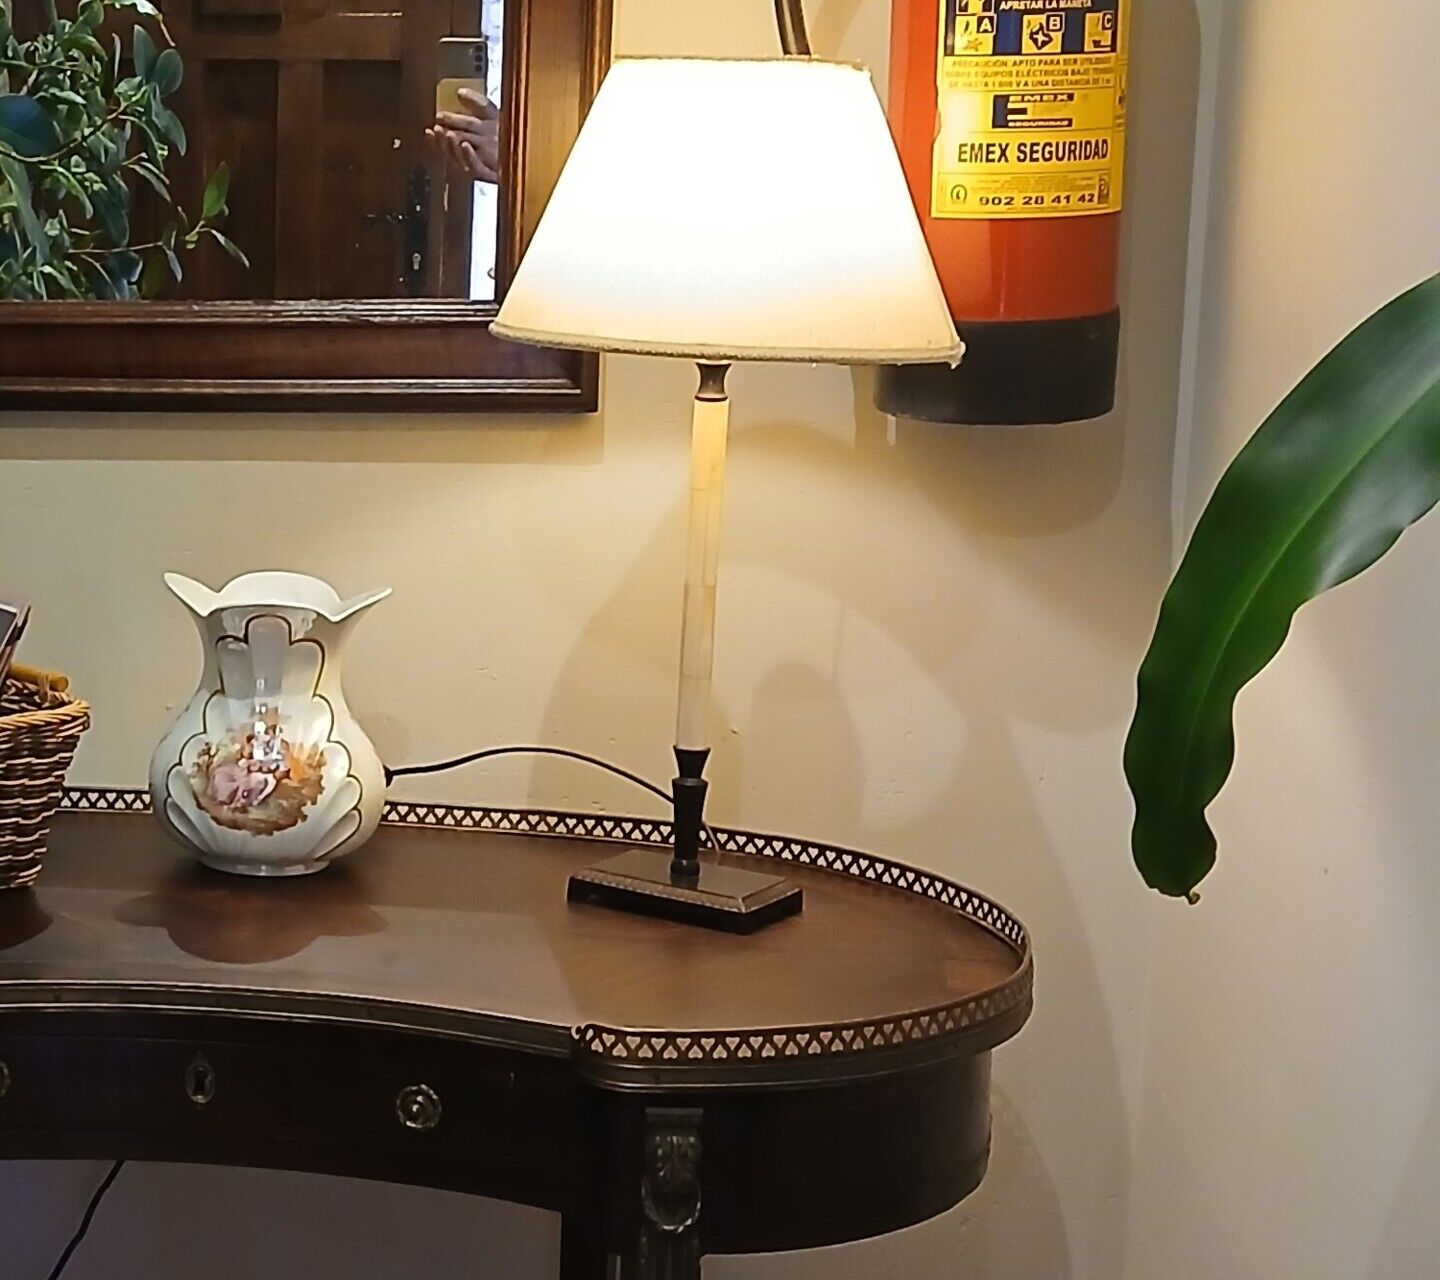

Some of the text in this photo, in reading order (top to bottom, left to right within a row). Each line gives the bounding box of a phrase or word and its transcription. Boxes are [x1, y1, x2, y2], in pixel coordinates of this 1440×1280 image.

[1045, 0, 1058, 9] LA
[978, 17, 992, 32] A
[1048, 16, 1061, 30] B
[1103, 14, 1113, 27] C
[1012, 57, 1036, 67] APTO
[1038, 57, 1061, 67] PARA
[1008, 93, 1069, 102] EMEX
[958, 138, 1109, 164] EMEX SEGURIDAD
[979, 195, 1015, 206] 902
[1050, 194, 1071, 205] 41
[1077, 193, 1095, 203] 42
